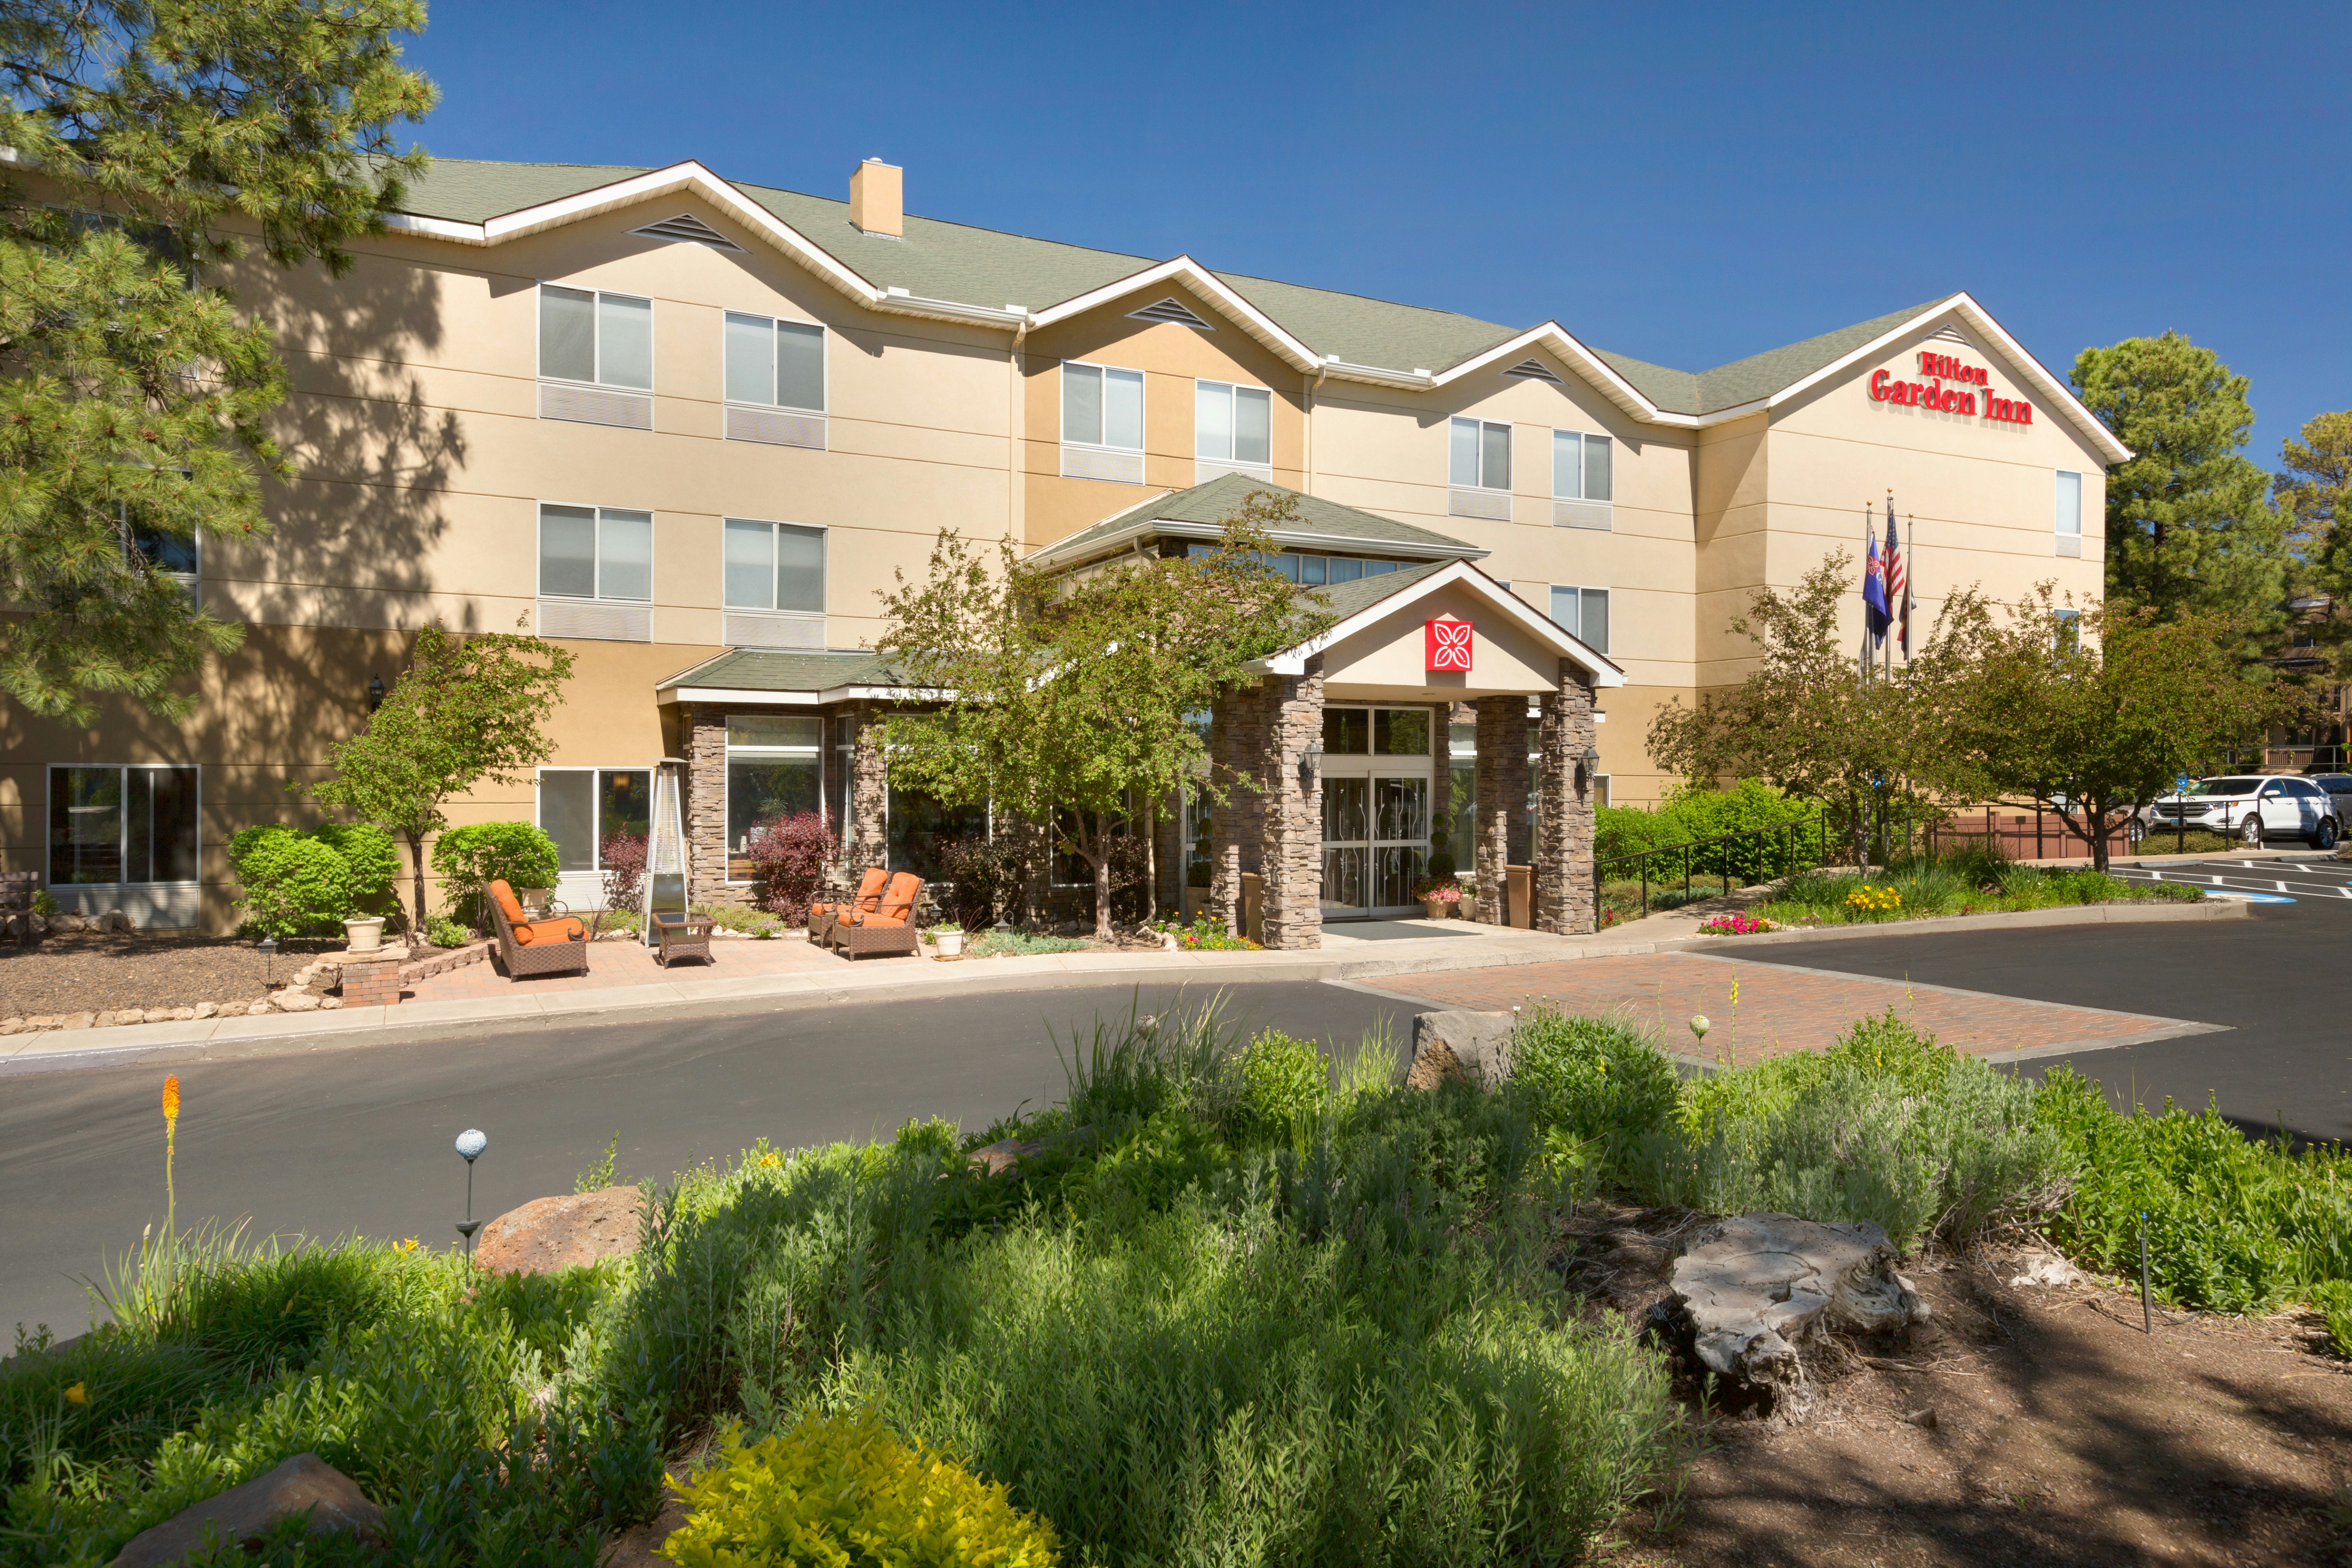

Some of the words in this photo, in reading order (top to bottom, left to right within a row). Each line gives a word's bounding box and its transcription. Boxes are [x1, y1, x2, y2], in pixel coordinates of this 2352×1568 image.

[1921, 351, 1988, 385] Hilton
[1871, 369, 1977, 416] Garden
[1984, 388, 2033, 425] Inn
